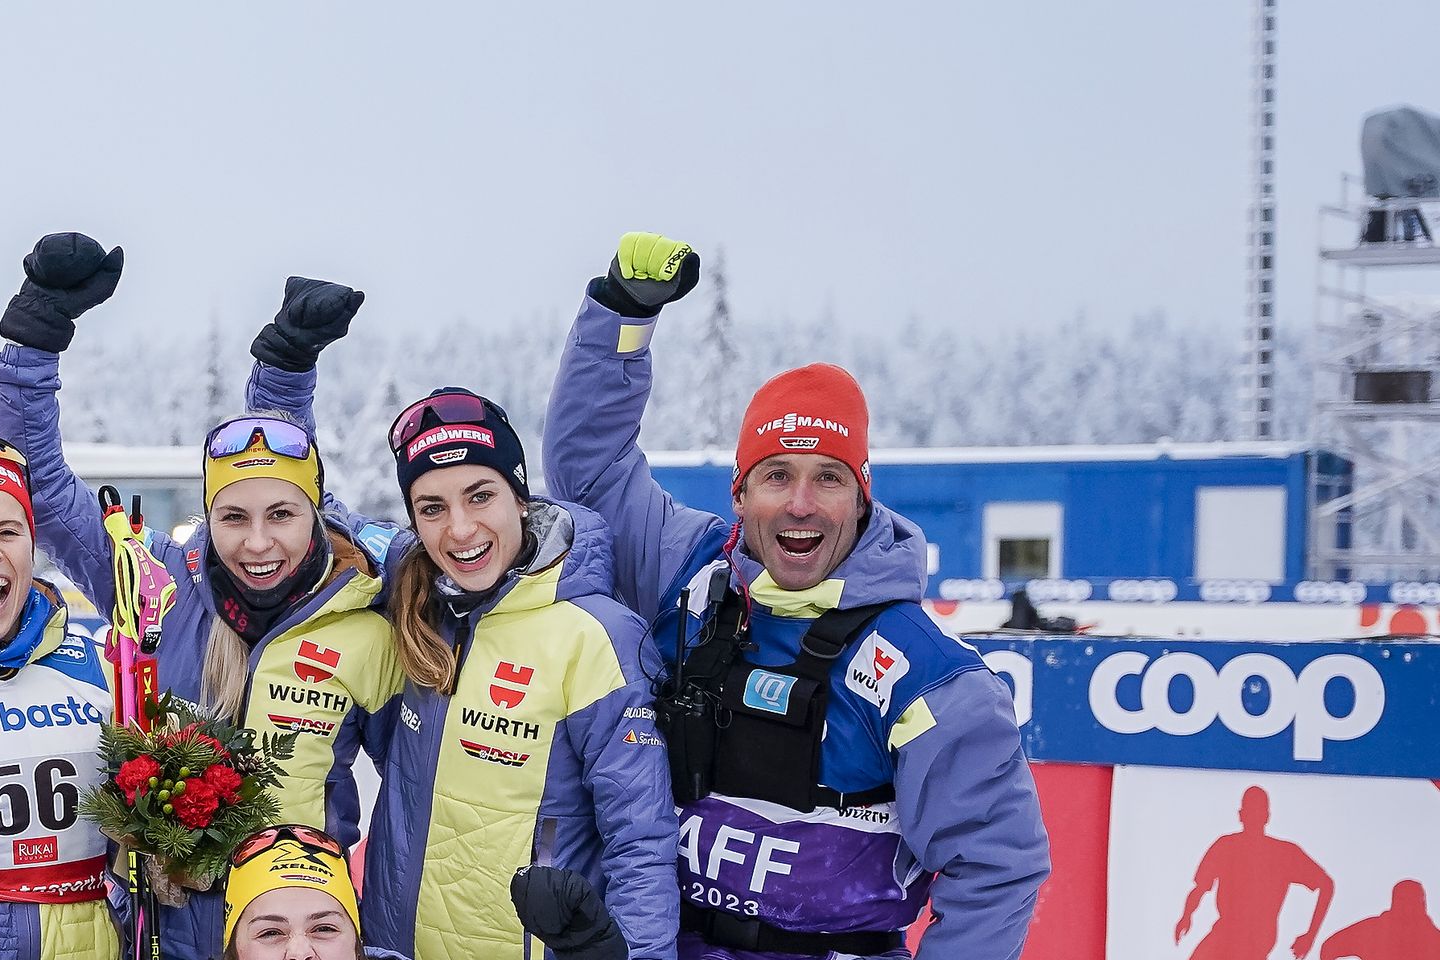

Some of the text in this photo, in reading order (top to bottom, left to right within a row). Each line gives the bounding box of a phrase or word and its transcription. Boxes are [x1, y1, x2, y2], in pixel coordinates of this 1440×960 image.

[409, 427, 492, 457] HANDWERK
[268, 683, 349, 712] WÜRTH
[754, 671, 786, 707] TQ
[1088, 651, 1386, 762] coop
[461, 707, 540, 740] WÜRTH
[489, 746, 531, 768] DSV
[676, 806, 800, 893] AFF
[269, 864, 335, 877] AXELENT
[690, 881, 759, 916] 2023
